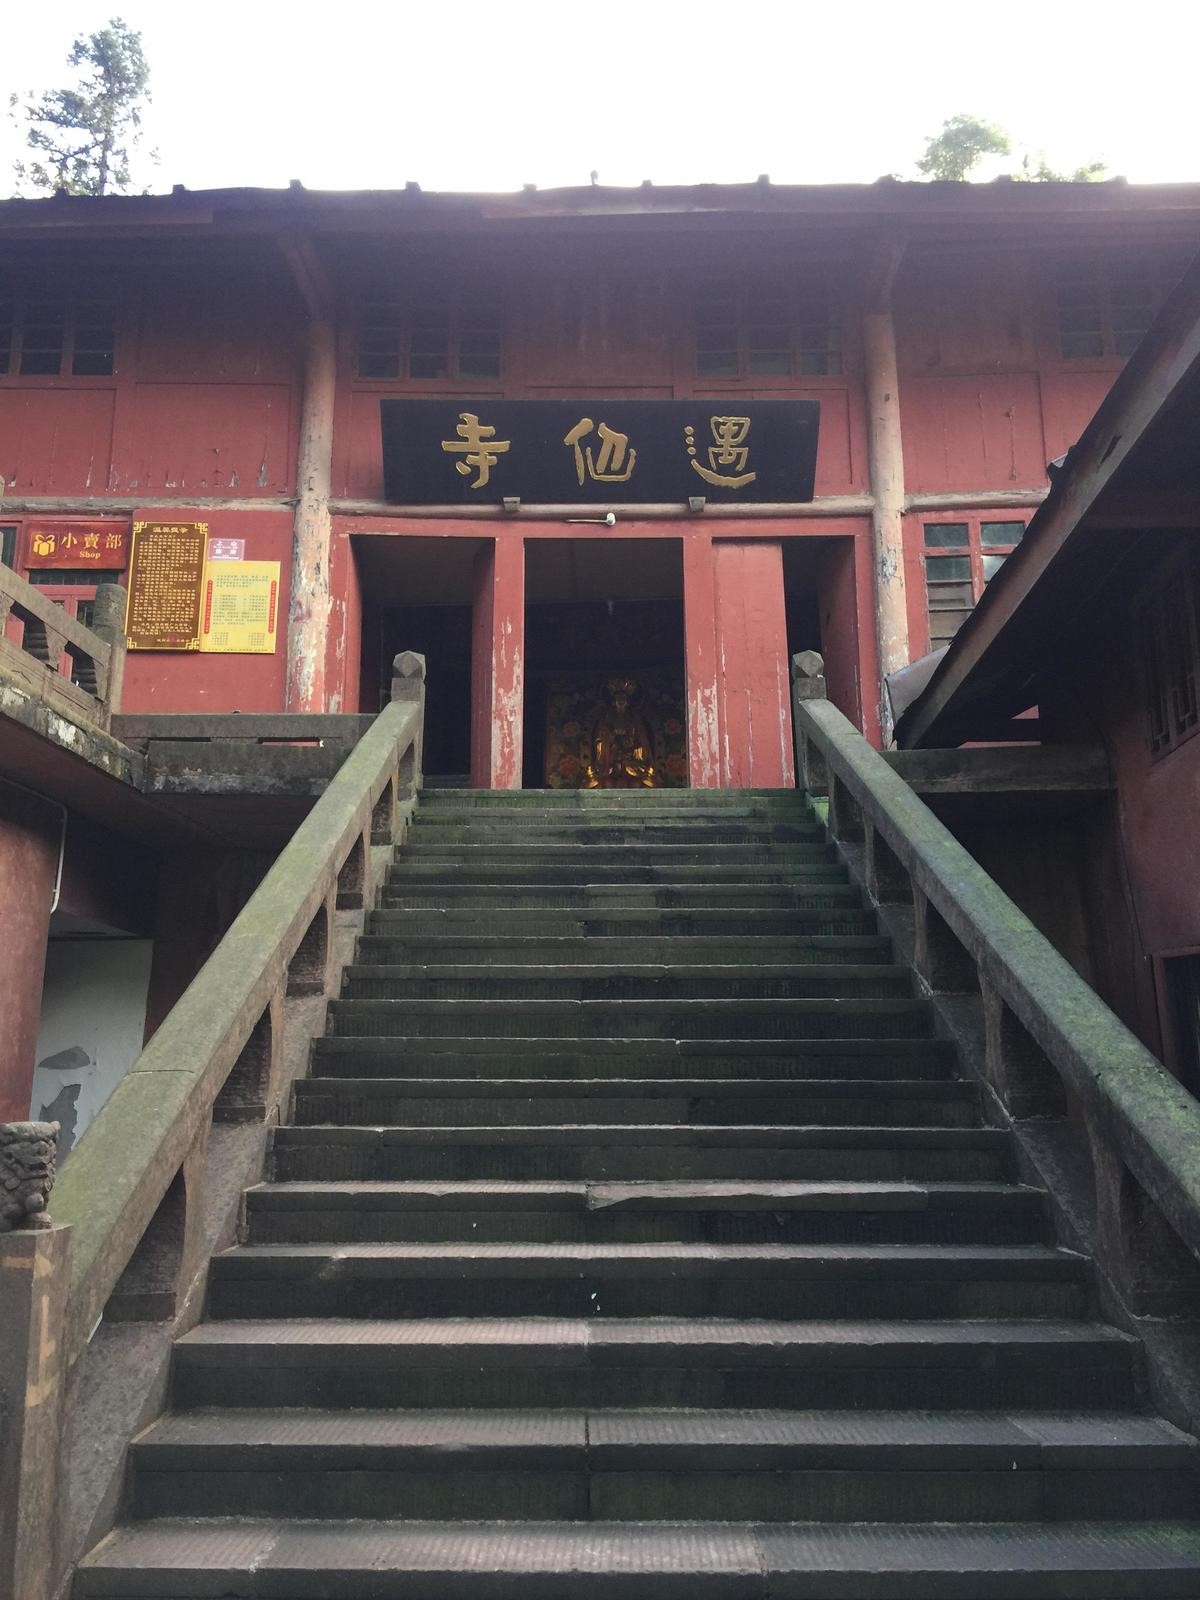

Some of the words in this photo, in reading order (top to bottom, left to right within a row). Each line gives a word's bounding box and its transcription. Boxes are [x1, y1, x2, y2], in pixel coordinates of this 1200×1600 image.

[61, 532, 122, 549] 小賣部
[79, 551, 101, 559] Shop
